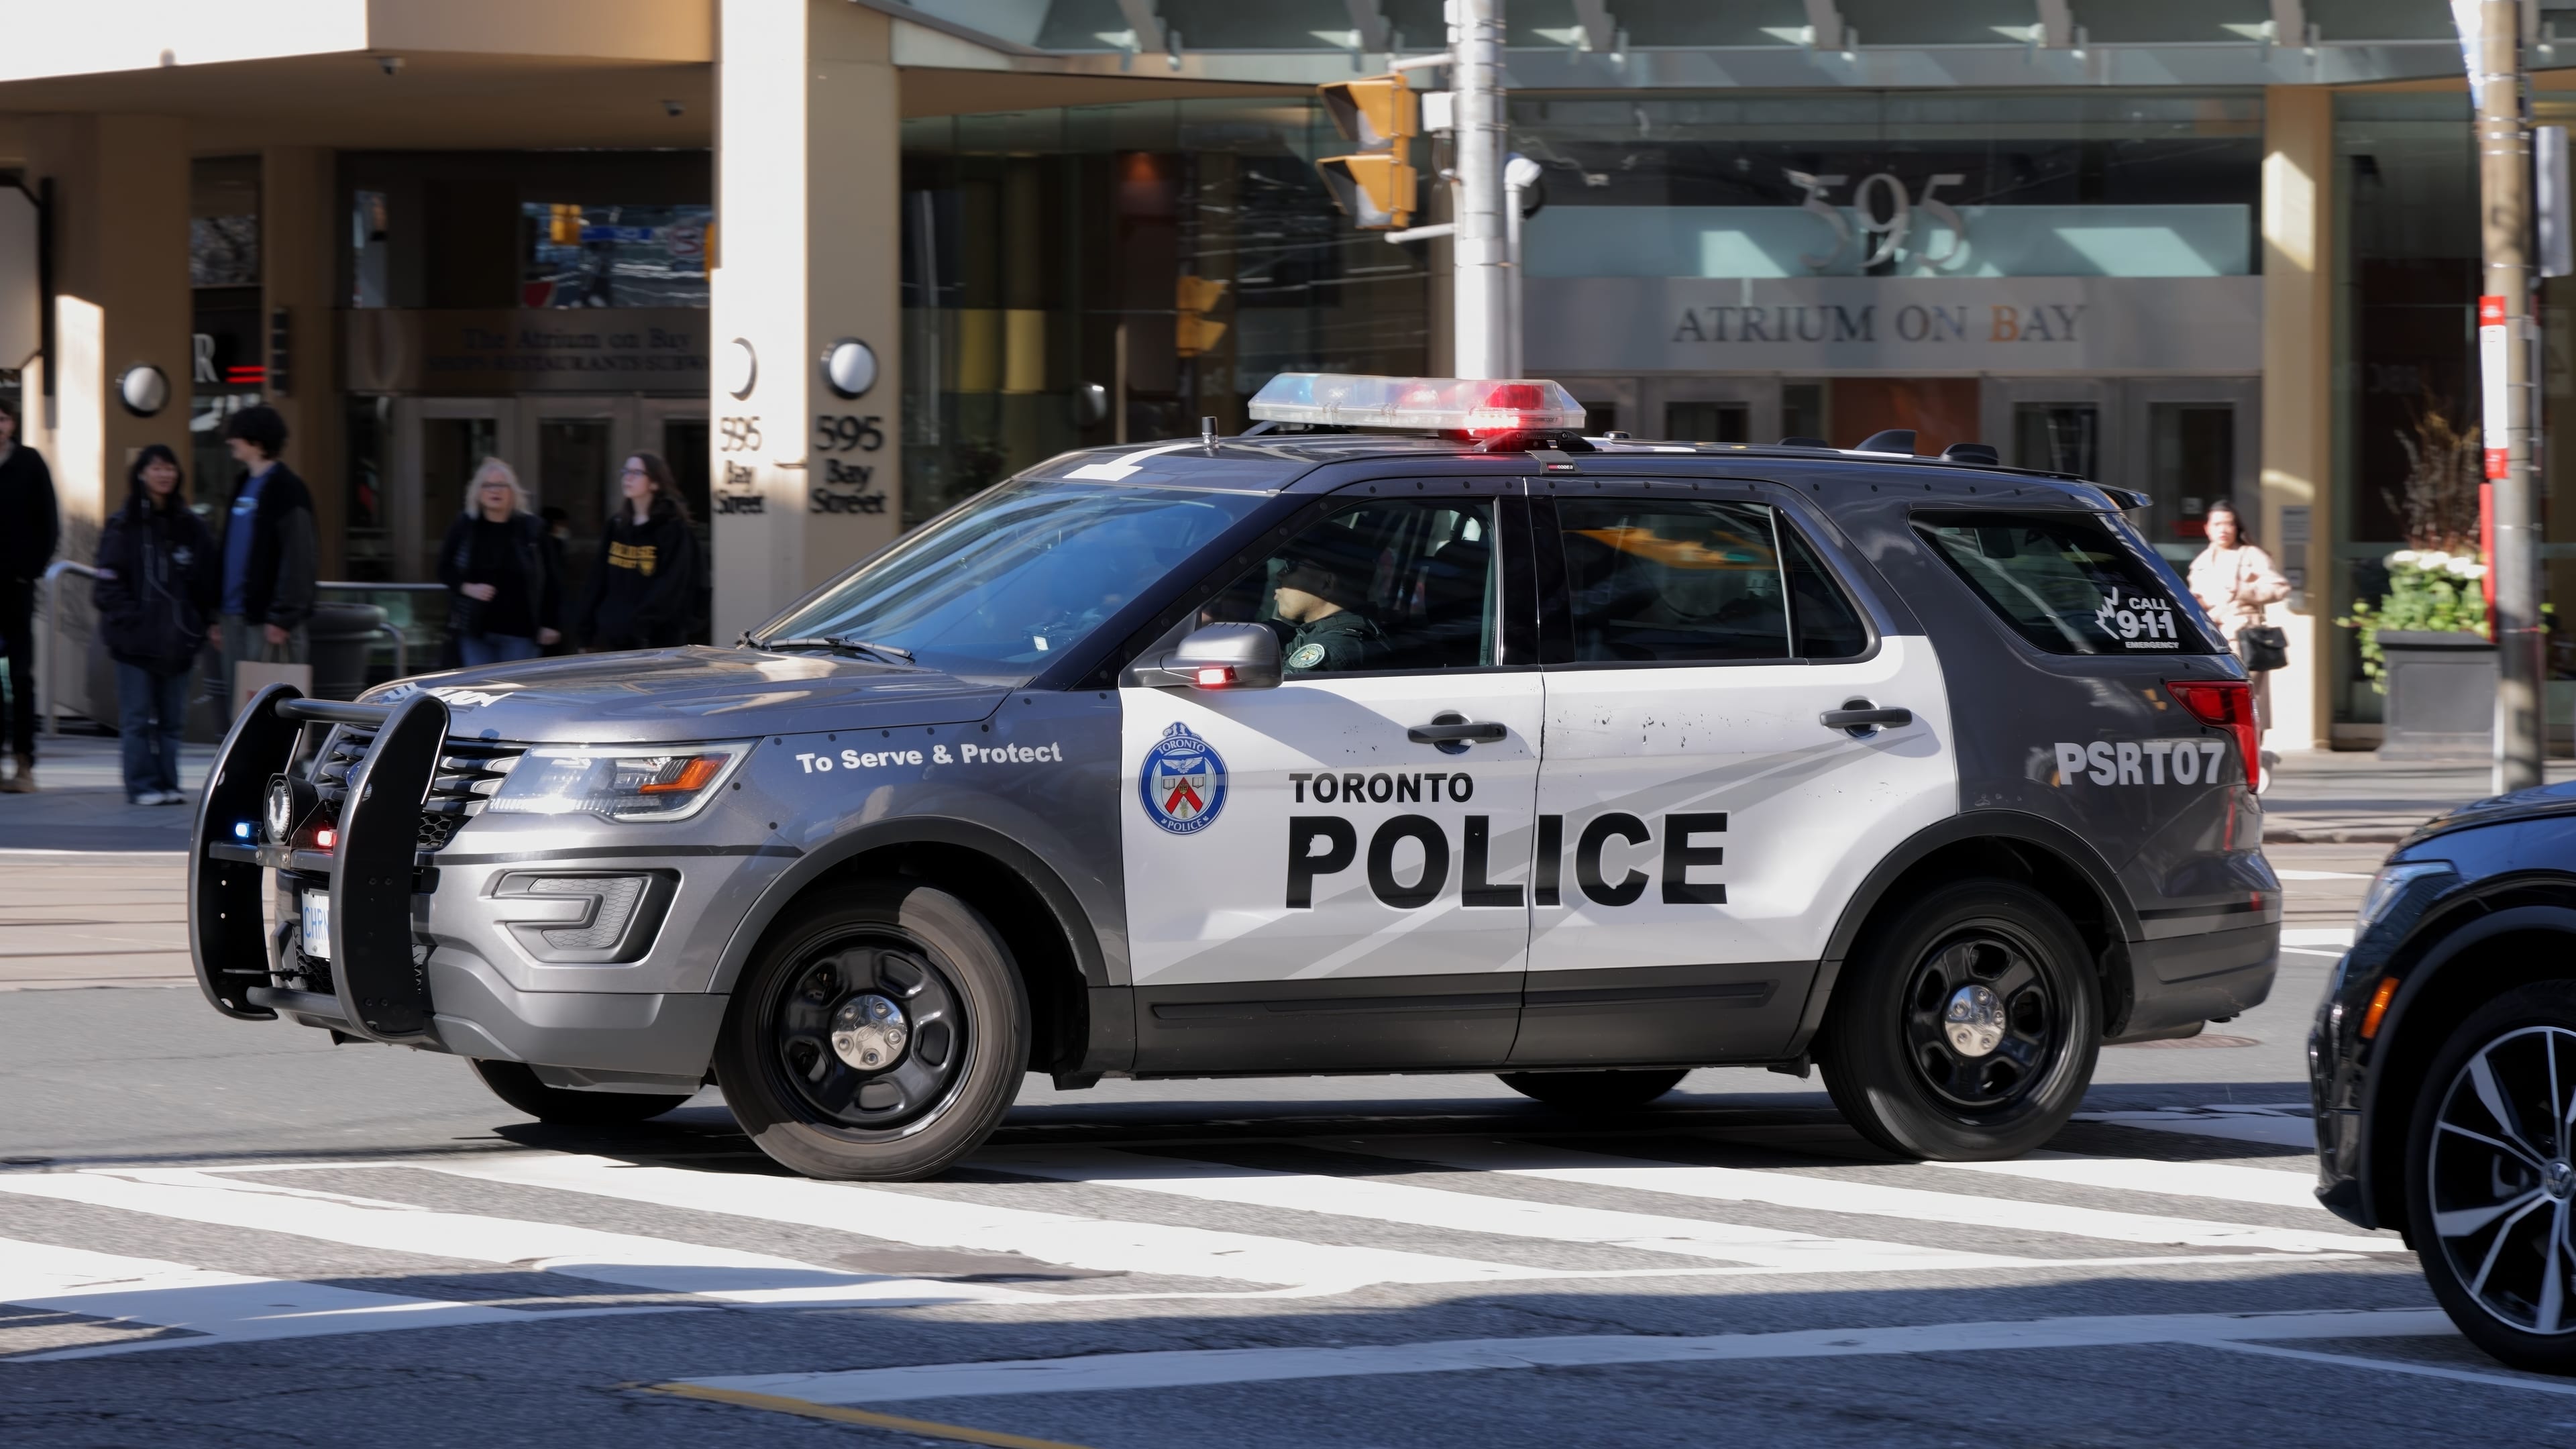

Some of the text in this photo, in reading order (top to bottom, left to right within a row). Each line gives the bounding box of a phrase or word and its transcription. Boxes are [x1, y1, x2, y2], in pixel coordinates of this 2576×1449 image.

[1800, 173, 1966, 268] 595
[515, 327, 601, 349] Atrium
[608, 333, 641, 349] on
[648, 327, 692, 352] Bay
[1672, 305, 2088, 342] ATRIUM ON BAY
[720, 416, 762, 451] 595
[816, 415, 883, 452] 595
[825, 458, 875, 493] Bay
[810, 488, 887, 514] Street
[2129, 597, 2171, 610] CALL
[796, 741, 1063, 773] To Serve & Protect
[1157, 739, 1206, 755] TORONTO
[2054, 741, 2226, 786] PSRT07
[1289, 773, 1474, 803] TORONTO
[1167, 818, 1203, 831] POLICE
[1285, 812, 1729, 910] POLICE
